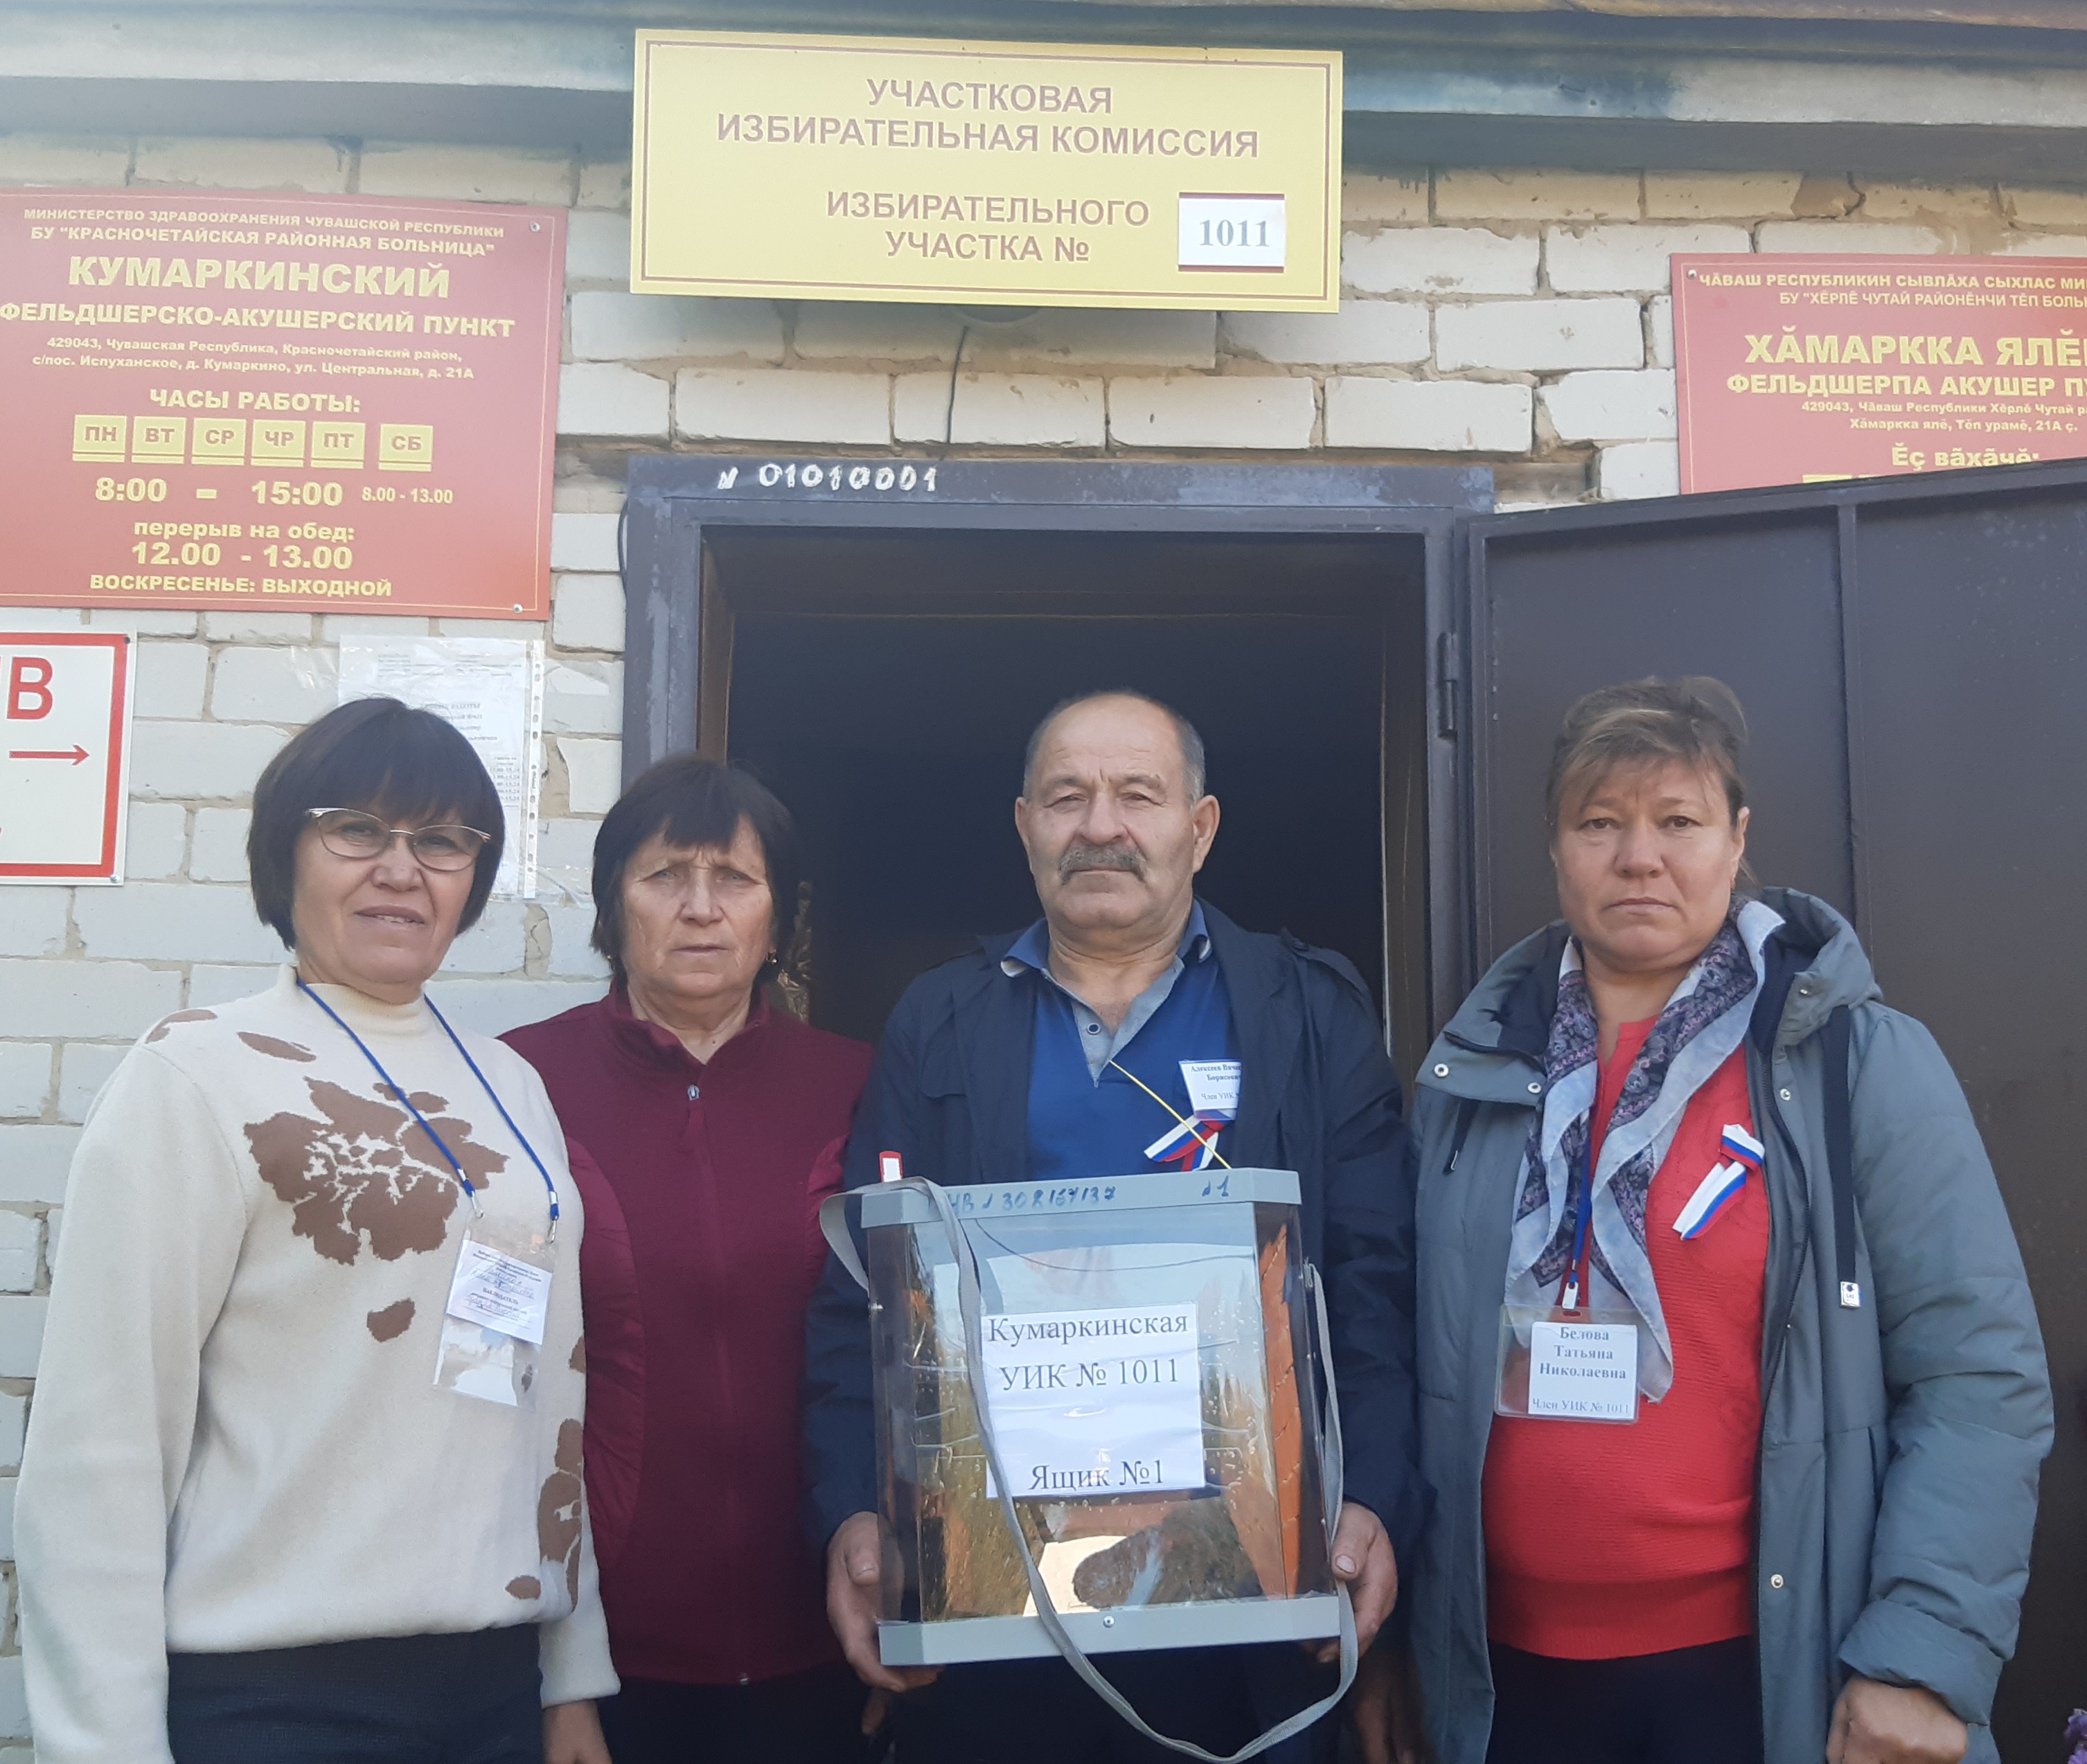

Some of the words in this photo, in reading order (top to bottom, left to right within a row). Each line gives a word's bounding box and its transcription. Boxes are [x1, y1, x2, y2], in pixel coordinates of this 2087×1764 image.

[867, 78, 1112, 114] УЧАСТКОВАЯ
[718, 113, 1039, 152] ИЗБИРАТЕЛЬНАЯ
[1051, 125, 1258, 158] КОМИССИЯ
[827, 191, 1150, 226] ИЗБИРАТЕЛЬНОГО
[24, 208, 145, 221] МИНИСТЕРСТВО
[149, 211, 301, 226] ЗДРАВООХРАНЕНИЯ
[305, 216, 400, 231] ЧУВАШСКОЙ
[404, 222, 504, 238] РЕСПУБЛИКИ
[1199, 219, 1270, 247] 1011
[30, 226, 55, 240] БУ
[60, 226, 259, 244] "КРАСНОЧЕТАЙСКАЯ
[265, 231, 372, 250] РАЙОННАЯ
[377, 237, 495, 258] БОЛЬНИЦА"
[885, 230, 1044, 261] УЧАСТКА
[1054, 237, 1090, 262] №
[69, 256, 450, 299] КУМАРКИНСКИЙ
[1766, 274, 1890, 287] РЕСПУБЛИКИН
[1984, 276, 2056, 289] СЫХЛАС
[2060, 278, 2087, 290] МИ
[1779, 292, 1799, 305] БУ
[1863, 291, 1910, 305] ЧУТАЙ
[0, 303, 414, 333] ФЕЛЬДШЕРСКО-АКУШЕРСКИЙ
[423, 315, 515, 337] ПУНКТ
[47, 337, 102, 350] 429043,
[106, 338, 185, 351] Чувашская
[188, 340, 278, 355] Республика,
[282, 343, 411, 359] Красночетайский
[414, 348, 462, 363] район,
[33, 355, 75, 366] с/пос.
[80, 355, 183, 371] Испуханское,
[185, 359, 200, 371] д.
[204, 359, 291, 373] Кумаркино,
[294, 364, 317, 375] ул.
[321, 362, 423, 378] Центральная,
[427, 368, 441, 379] д.
[445, 367, 474, 380] 21А
[1726, 374, 1933, 398] ФЕЛЬДШЕРПА
[1939, 376, 2056, 397] АКУШЕР
[150, 389, 229, 409] ЧАСЫ
[238, 391, 360, 413] РАБОТЫ:
[1801, 401, 1854, 413] 429043,
[1906, 402, 1987, 414] Республики
[2034, 403, 2074, 416] Чутай
[85, 426, 117, 442] ПН
[145, 427, 175, 443] ВТ
[205, 429, 235, 445] СР
[265, 430, 294, 447] ЧР
[323, 432, 355, 449] ПТ
[391, 435, 423, 451] СБ
[2035, 420, 2062, 431] 21А
[758, 463, 936, 492] 01010001
[95, 477, 168, 502] 8:00
[251, 481, 344, 506] 15:00
[362, 486, 396, 502] 8.00
[410, 488, 454, 504] 13.00
[134, 522, 242, 540] перерыв
[250, 524, 280, 539] на
[287, 522, 355, 543] обед:
[132, 541, 221, 567] 12.00
[263, 544, 353, 569] 13.00
[89, 574, 256, 593] ВОСКРЕСЕНЬЕ:
[262, 578, 392, 598] ВЫХОДНОЙ
[0, 656, 53, 720] В
[988, 1315, 1189, 1347] Кумаркинская
[1560, 1326, 1609, 1341] Белова
[1554, 1344, 1613, 1360] Татьяна
[999, 1363, 1067, 1391] УИК
[1076, 1362, 1107, 1387] №
[1119, 1358, 1178, 1384] 1011
[1539, 1362, 1626, 1380] Николаевна
[1532, 1398, 1558, 1410] Член
[1561, 1400, 1588, 1411] УИК
[1606, 1402, 1628, 1414] 1011
[1028, 1464, 1110, 1490] Ящик
